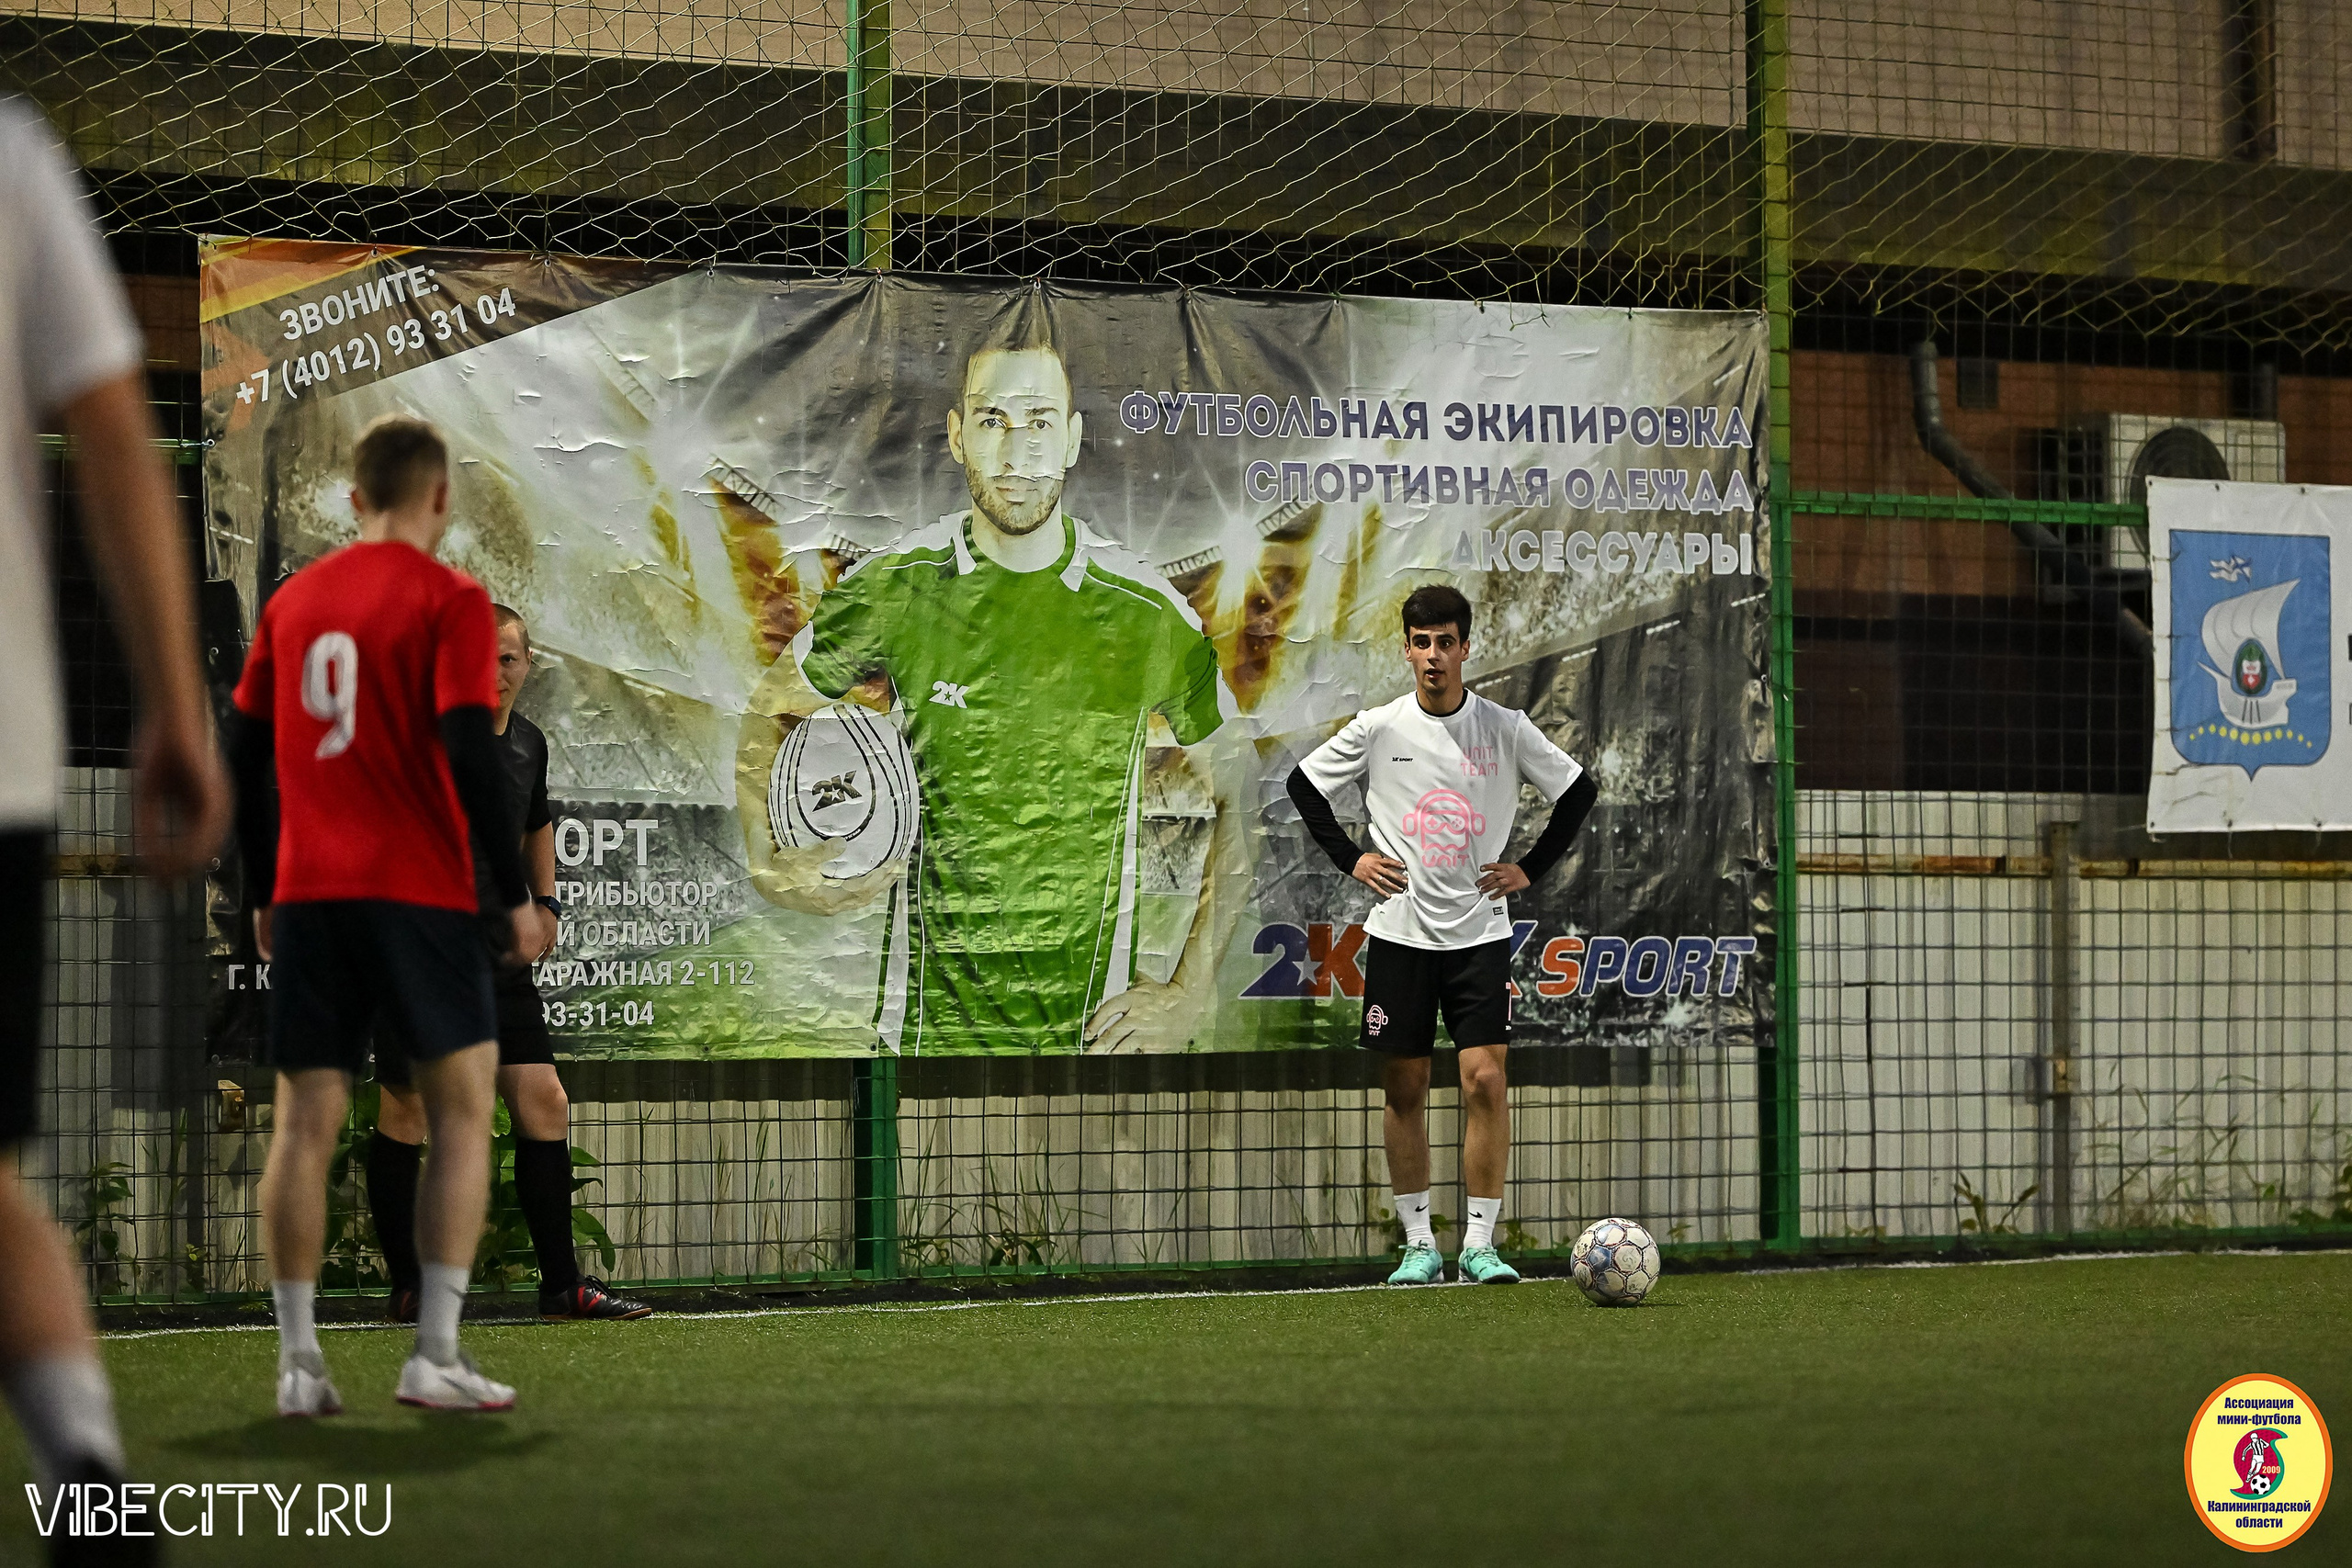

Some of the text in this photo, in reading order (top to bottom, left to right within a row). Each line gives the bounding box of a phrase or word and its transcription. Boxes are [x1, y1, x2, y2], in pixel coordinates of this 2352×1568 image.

[279, 265, 439, 340] ЗВОНИТЕ:
[236, 288, 516, 403] +7 (4012) 93 31 04
[1120, 389, 1752, 449] ФУТБОЛЬНАЯ ЭКИПИРОВКА
[1245, 459, 1754, 513] СПОРТИВНАЯ ОДЕЖДА
[1452, 529, 1752, 576] АКСЕССУАРЫ
[301, 630, 358, 761] 9
[929, 680, 970, 709] 2K
[1460, 761, 1498, 776] TEAM
[1463, 745, 1494, 761] UNIT
[811, 770, 863, 812] 2K
[555, 818, 659, 866] ОРТ
[1421, 854, 1469, 868] UNIT
[554, 881, 718, 906] ТРИБЬЮТОР
[582, 920, 711, 946] ОБЛАСТИ
[228, 964, 246, 990] Г.
[679, 960, 755, 986] 2-112
[1536, 936, 1756, 998] SPORT
[542, 1000, 655, 1027] 3-31-04
